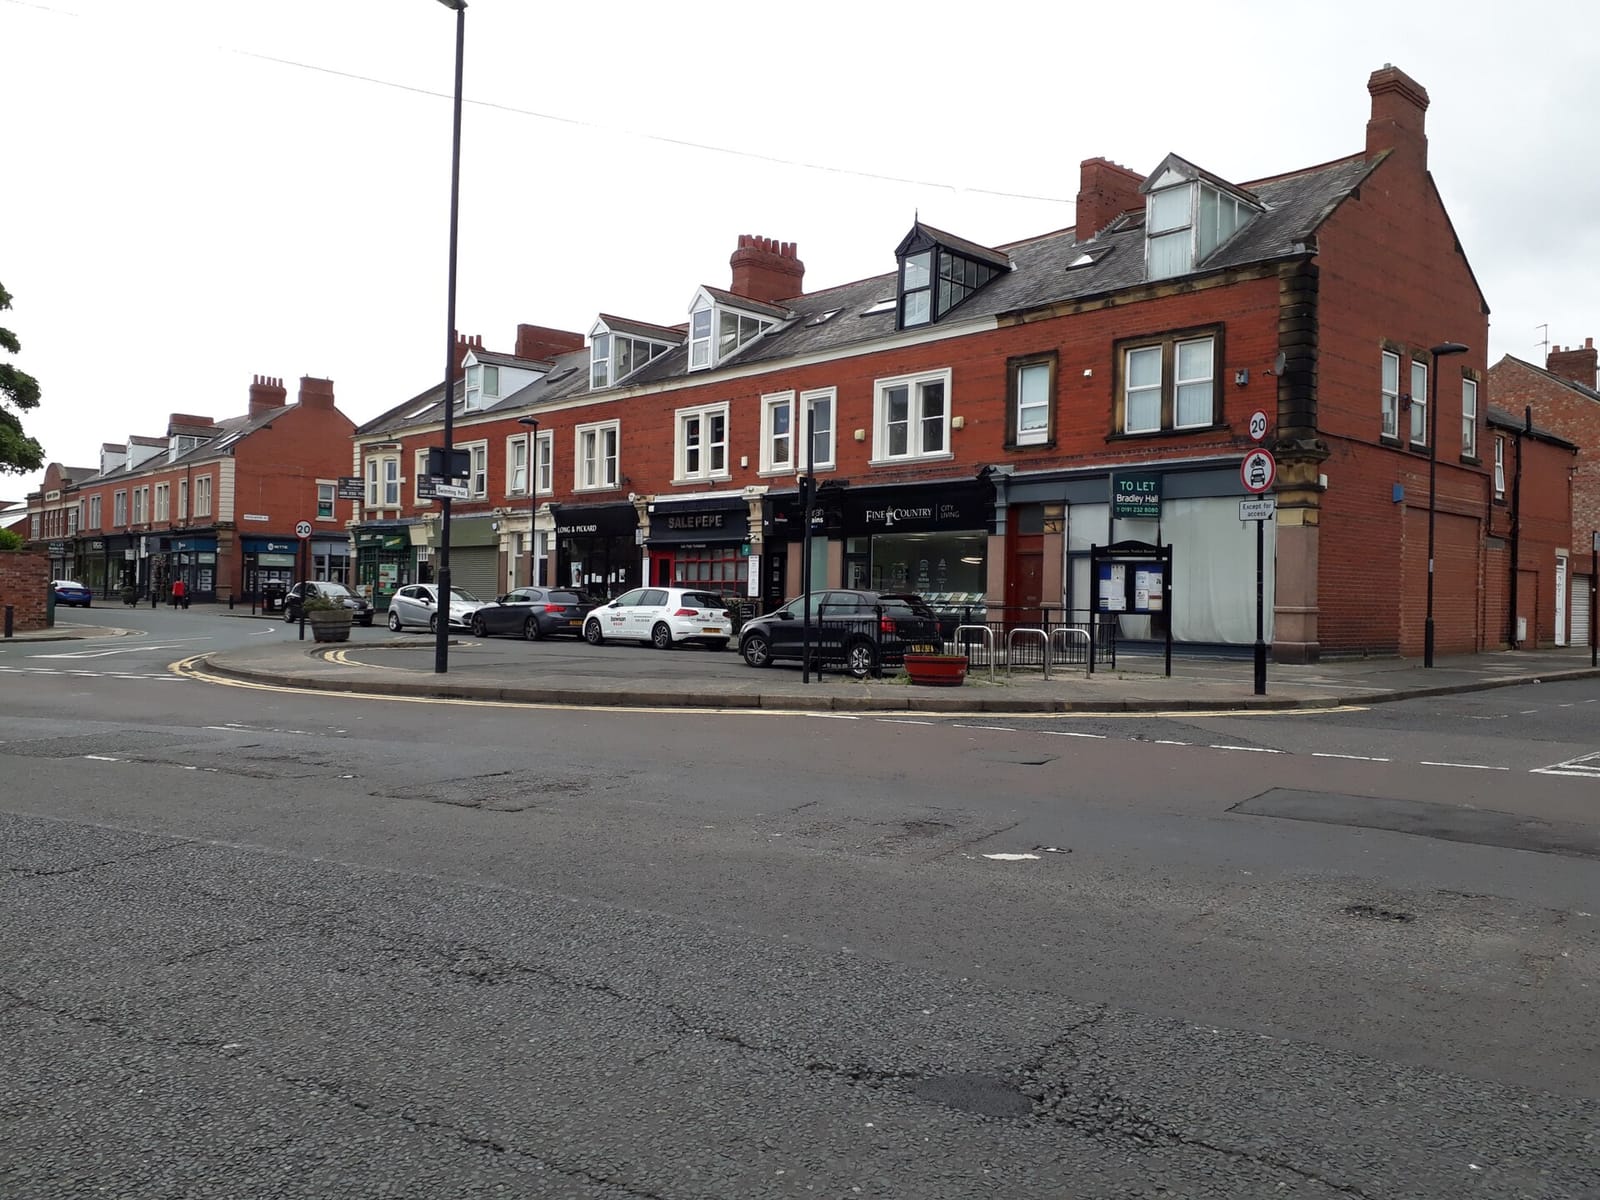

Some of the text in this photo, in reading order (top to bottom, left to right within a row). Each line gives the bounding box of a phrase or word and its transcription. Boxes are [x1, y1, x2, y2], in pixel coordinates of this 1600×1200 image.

[1251, 418, 1265, 434] 20
[1119, 480, 1156, 491] TO LET
[1116, 493, 1159, 505] Bradley Hall
[940, 503, 954, 512] CITY
[865, 508, 933, 523] FINE COUNTRY
[940, 510, 960, 519] LIVING
[668, 514, 723, 529] SALE PEPE
[297, 525, 311, 534] 20
[557, 524, 597, 534] LONG & PICKARD
